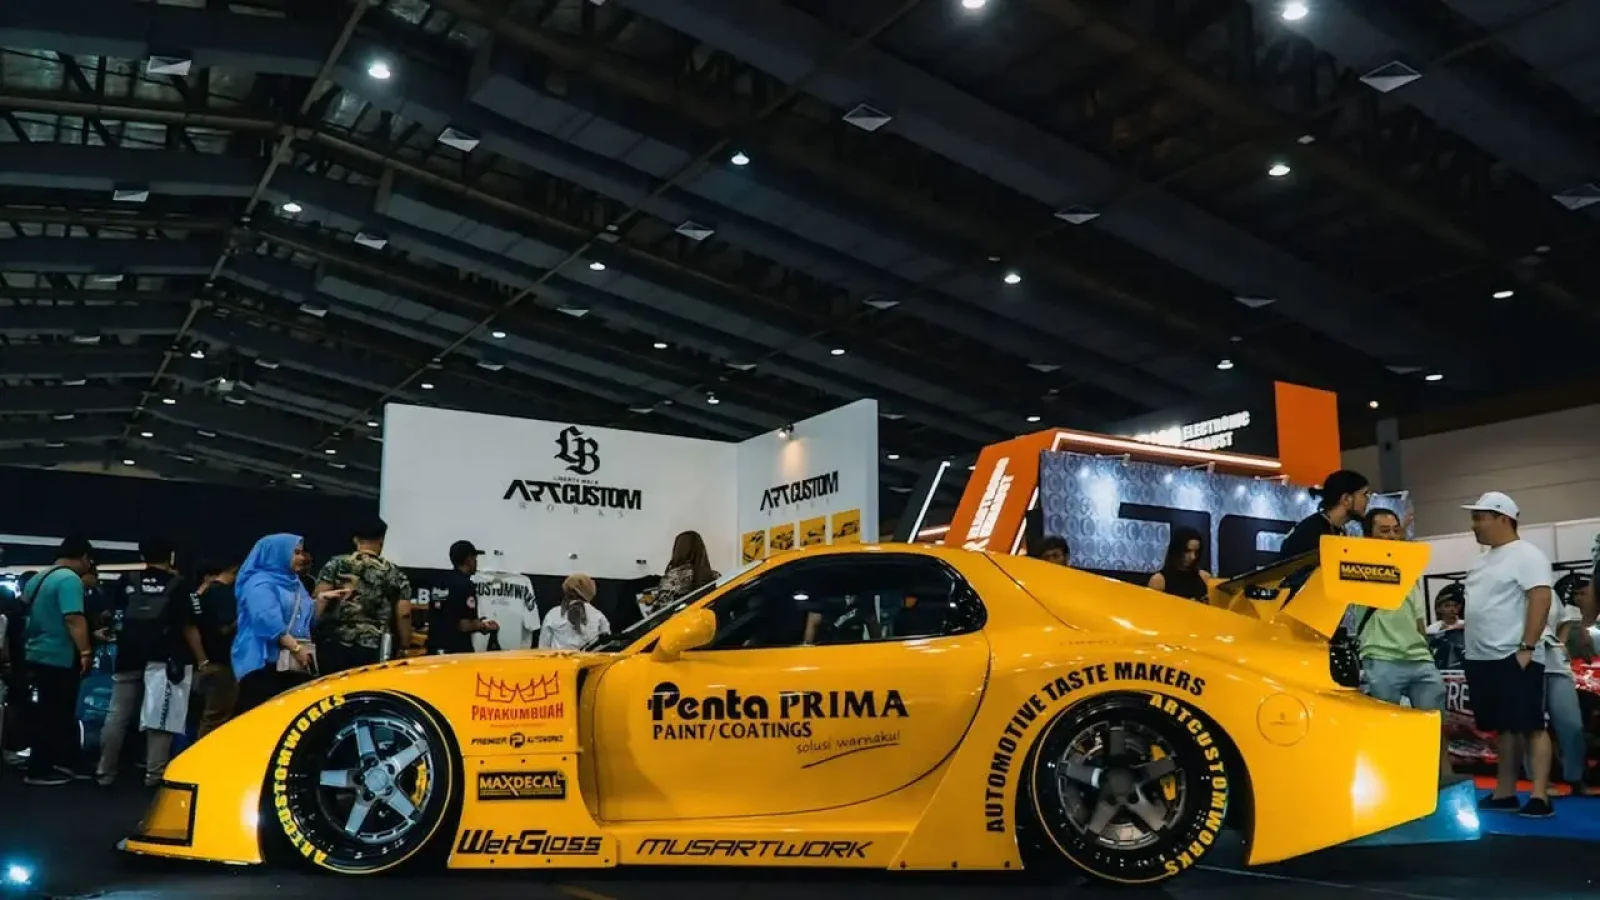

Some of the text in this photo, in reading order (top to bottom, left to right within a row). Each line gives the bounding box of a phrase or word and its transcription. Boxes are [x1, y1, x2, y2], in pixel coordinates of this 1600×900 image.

[1341, 564, 1398, 580] MAXDECAL
[472, 702, 564, 721] PAYAKUMBUAH
[648, 682, 909, 720] Penta PRIMA
[653, 721, 812, 741] PAINT/COATINGS
[796, 730, 901, 754] solusi warnaku!
[985, 662, 1206, 833] AUTOMOTIVE TASTE MAKERS
[480, 775, 561, 796] MAXDECAL
[1150, 694, 1228, 876] ARTCUSTOMWORKS
[636, 838, 873, 858] MUSARTWORK
